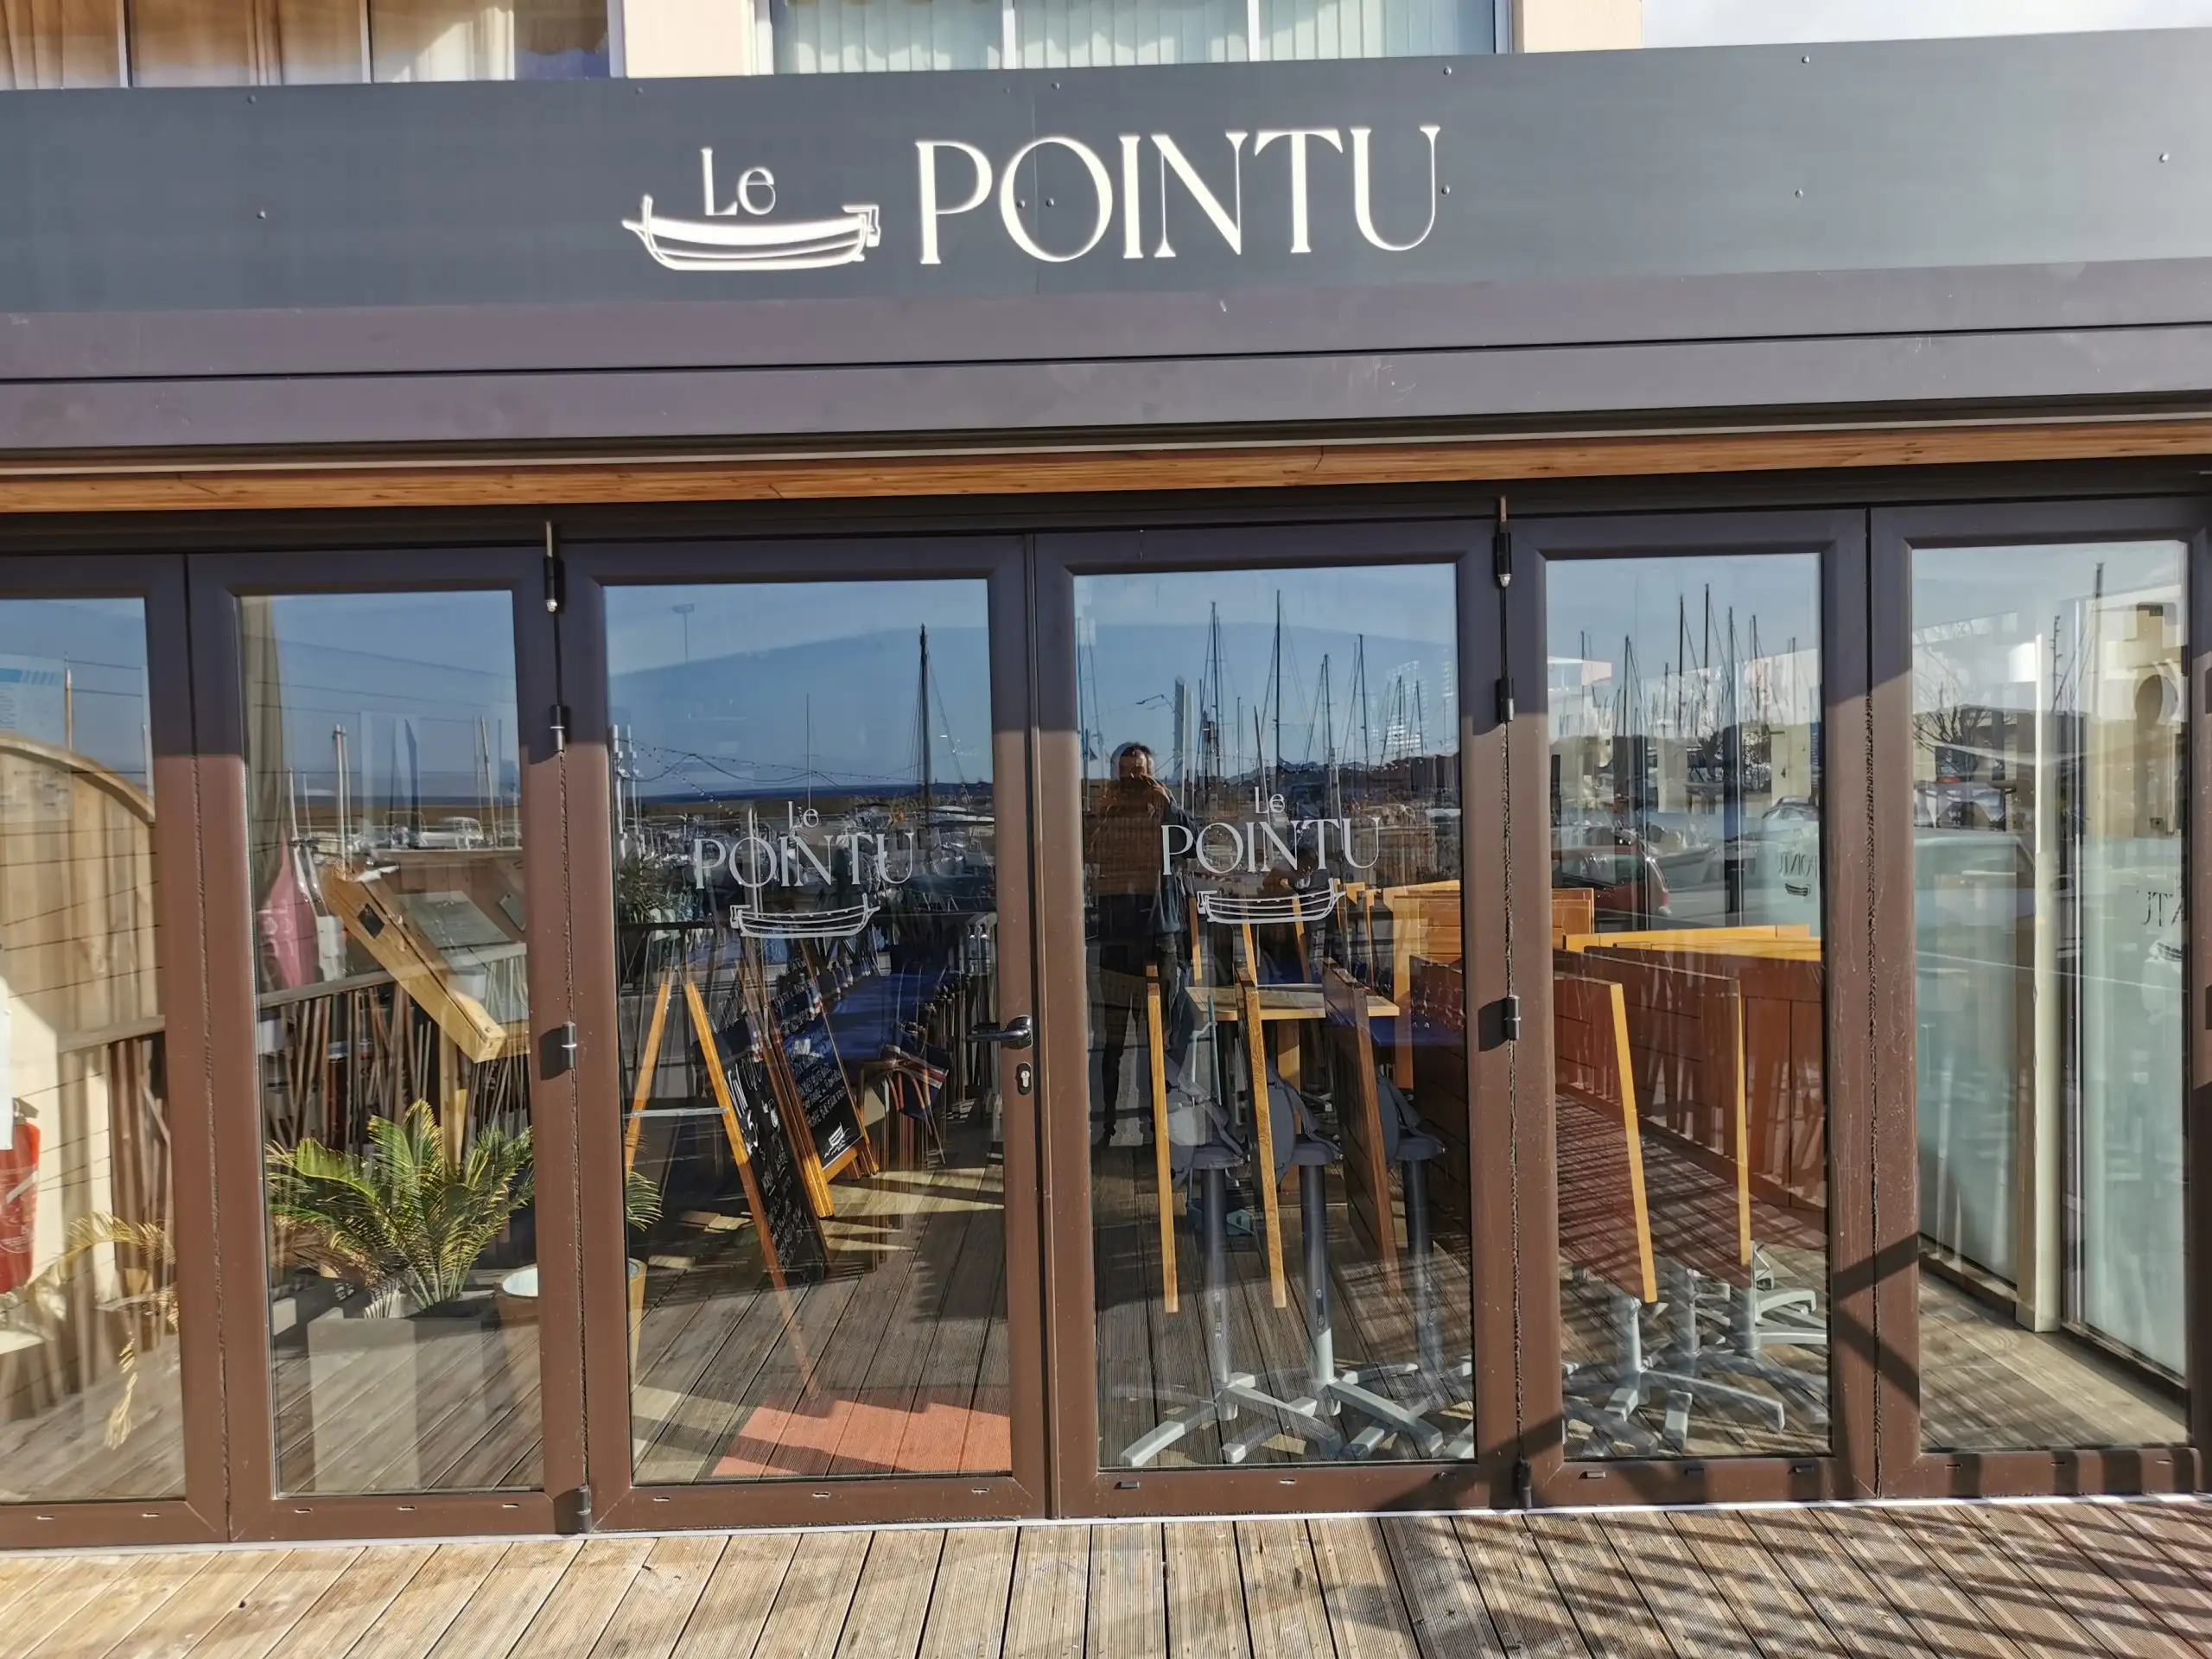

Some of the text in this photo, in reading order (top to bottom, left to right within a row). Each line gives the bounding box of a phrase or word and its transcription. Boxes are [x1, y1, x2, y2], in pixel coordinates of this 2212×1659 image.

[702, 124, 1441, 265] Le POINTU
[788, 801, 820, 830] Le
[1255, 786, 1286, 814] Le
[694, 832, 914, 890] POINTU
[1161, 817, 1382, 876] POINTU
